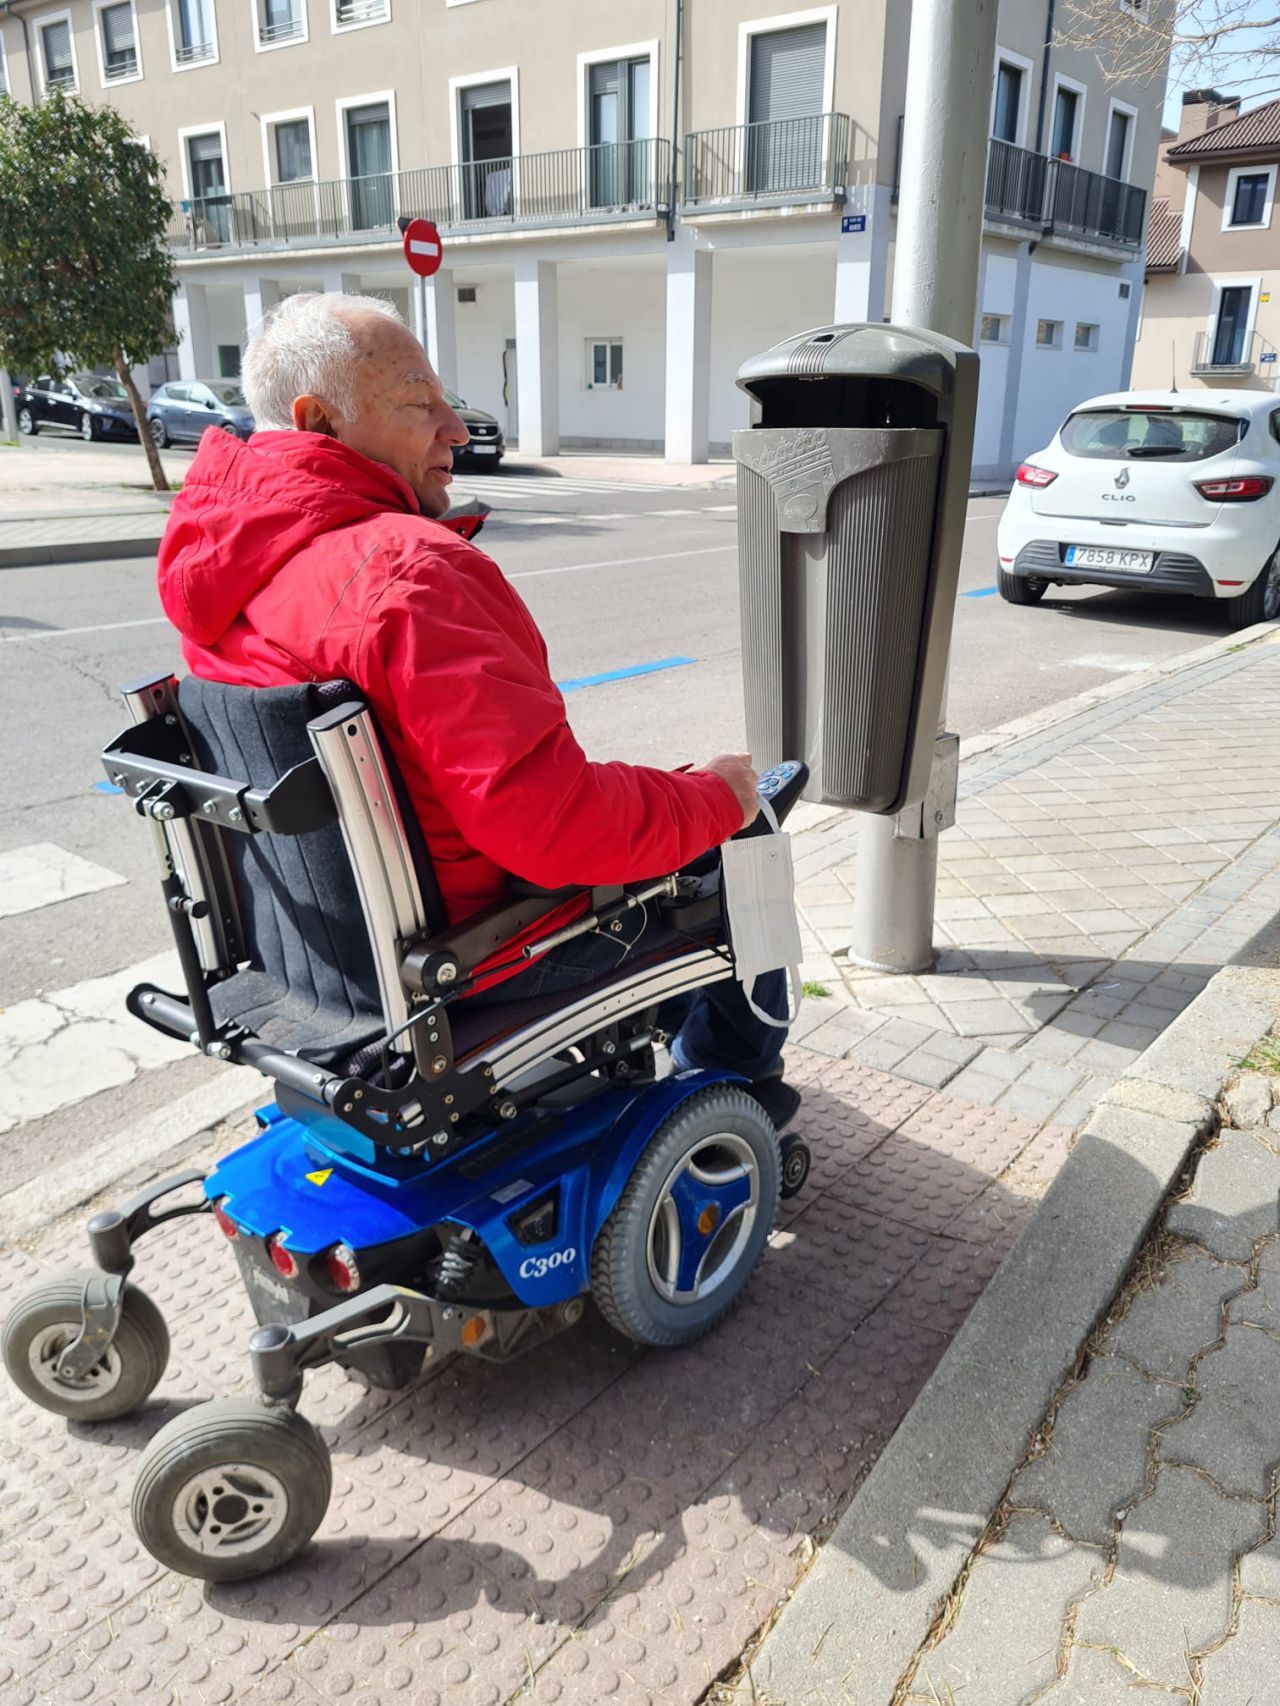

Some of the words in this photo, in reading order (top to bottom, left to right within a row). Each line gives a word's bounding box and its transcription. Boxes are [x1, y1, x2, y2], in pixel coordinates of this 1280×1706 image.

[1101, 494, 1136, 502] CLIO
[1076, 548, 1115, 564] 7858
[1119, 551, 1150, 567] KPX
[519, 1247, 576, 1278] C300
